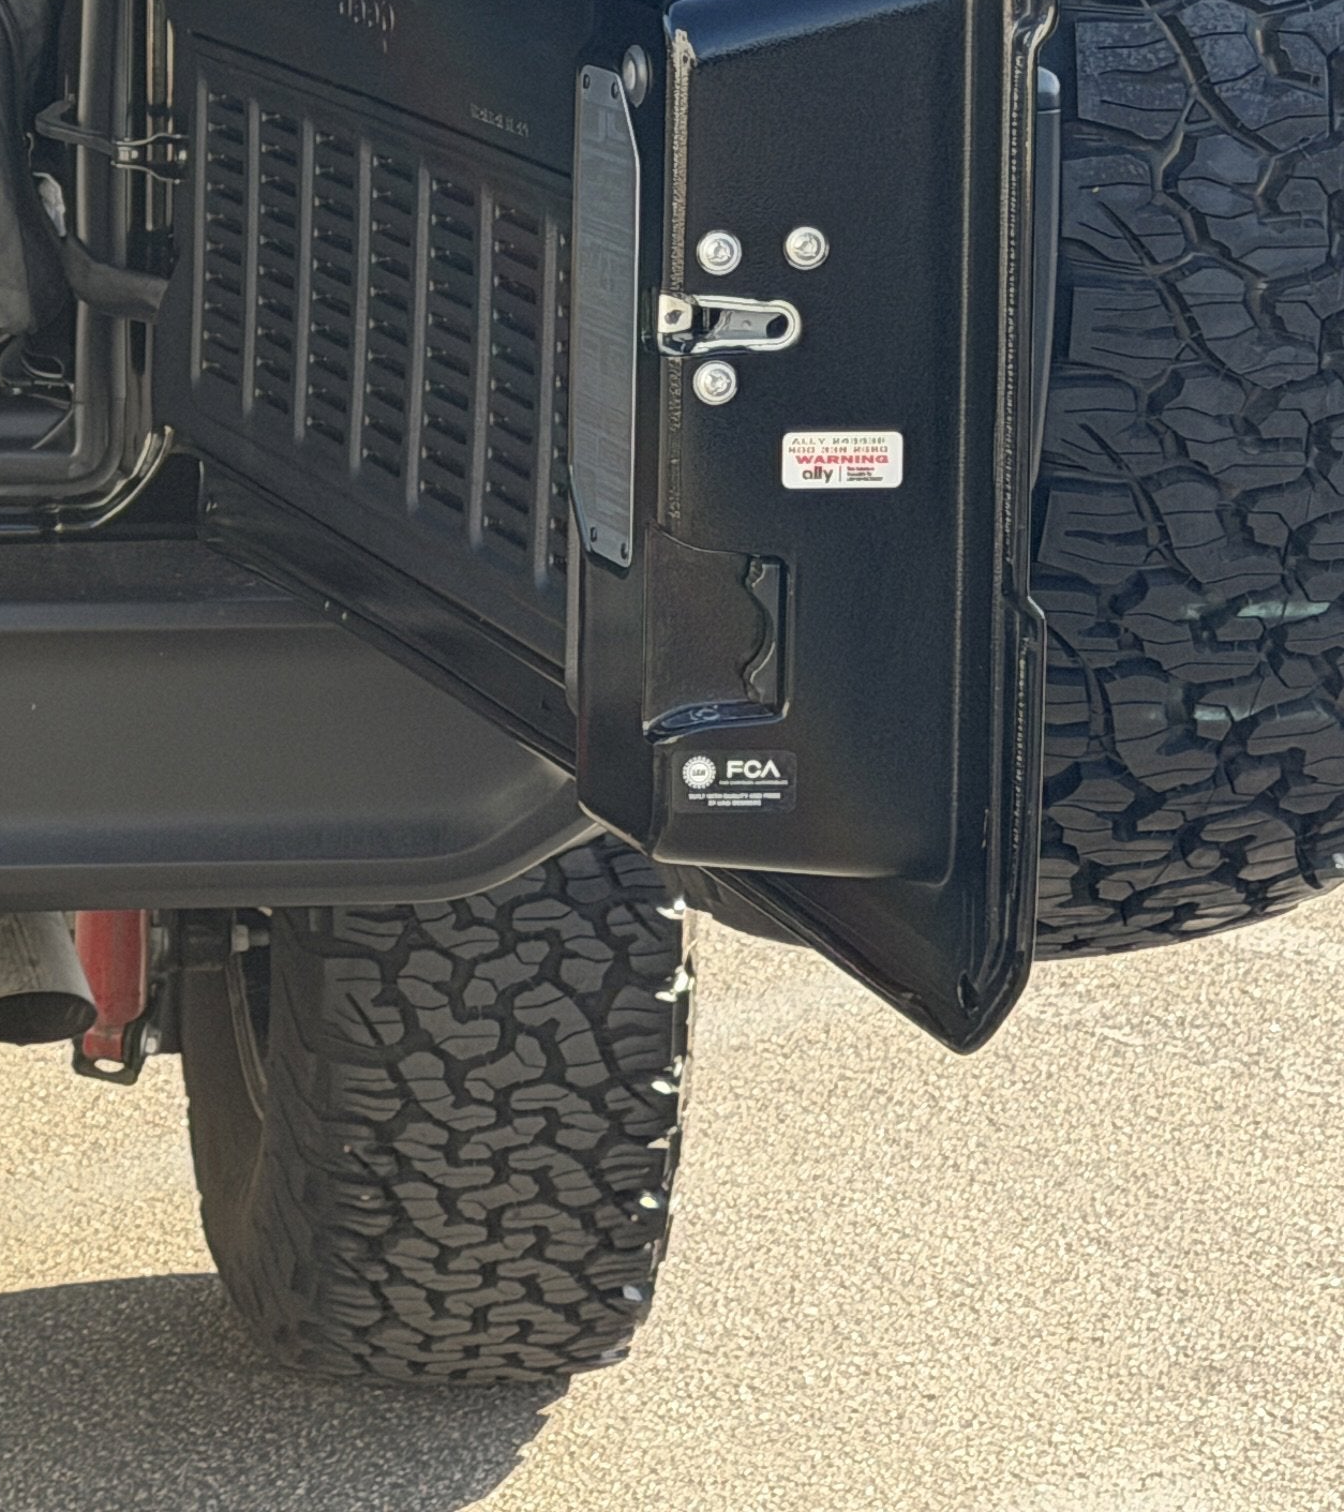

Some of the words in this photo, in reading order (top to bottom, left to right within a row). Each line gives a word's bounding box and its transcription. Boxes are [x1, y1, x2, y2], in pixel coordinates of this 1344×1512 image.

[794, 454, 889, 465] WARNING
[801, 465, 834, 484] ally
[725, 758, 782, 779] FCA
